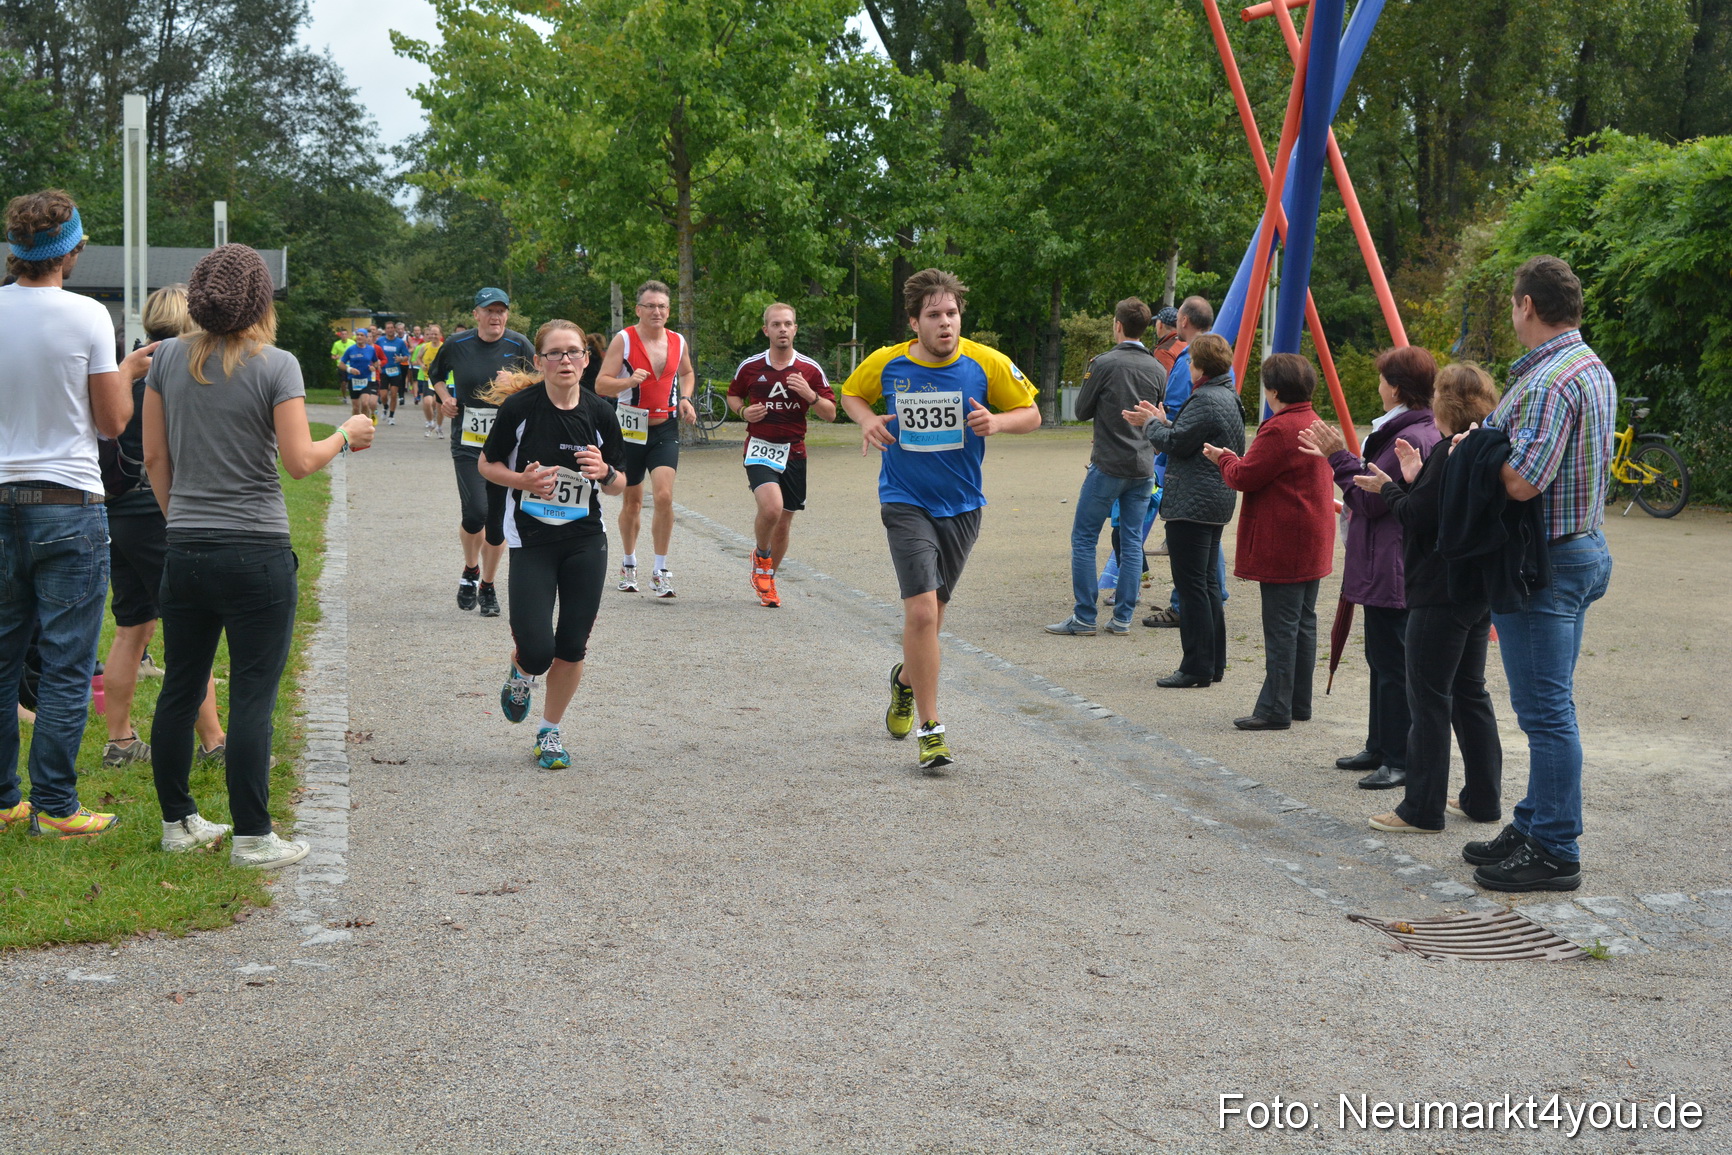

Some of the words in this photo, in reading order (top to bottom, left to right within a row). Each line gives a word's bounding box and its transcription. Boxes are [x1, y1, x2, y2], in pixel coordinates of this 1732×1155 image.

[759, 401, 801, 410] REVA
[903, 407, 957, 430] 3335
[750, 444, 785, 464] 2932
[552, 472, 583, 482] eumarkt
[0, 489, 42, 503] PMA
[543, 507, 566, 517] Irene
